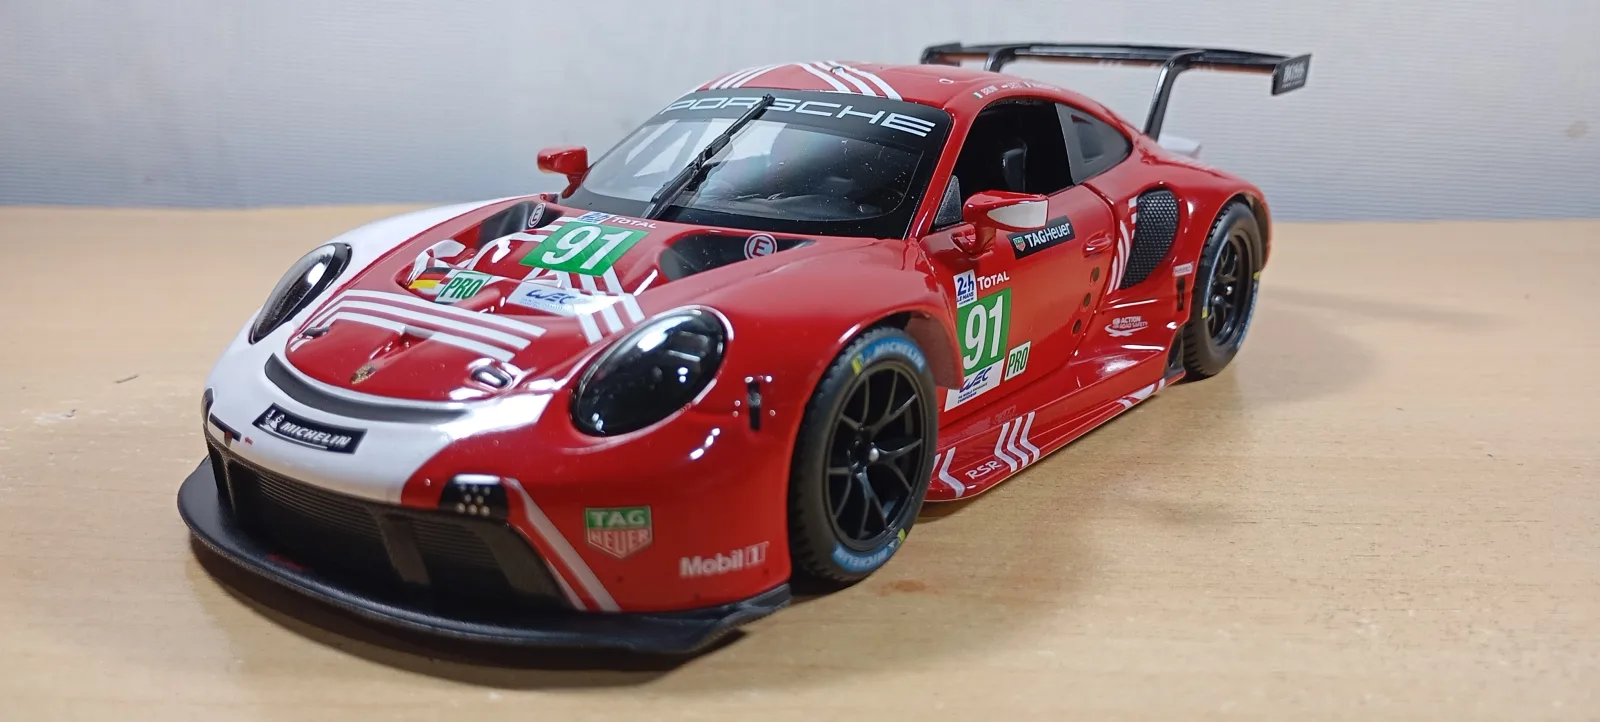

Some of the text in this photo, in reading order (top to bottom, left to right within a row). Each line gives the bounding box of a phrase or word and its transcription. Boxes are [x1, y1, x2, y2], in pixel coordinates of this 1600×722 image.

[659, 97, 936, 138] PORSCHE
[612, 216, 657, 229] TOTAL
[541, 225, 634, 270] 91
[440, 276, 484, 300] PRO
[957, 274, 975, 297] 24h
[977, 271, 1010, 291] TOTAL
[526, 289, 579, 305] WEC
[1120, 315, 1142, 324] ACTION
[963, 295, 1003, 370] 91
[1006, 346, 1029, 378] PRO
[959, 366, 993, 394] WEC
[280, 421, 353, 447] MICHELIN
[965, 460, 1002, 480] RSR
[590, 509, 645, 527] TAG
[589, 528, 650, 554] HEUER
[679, 548, 744, 578] Mobil
